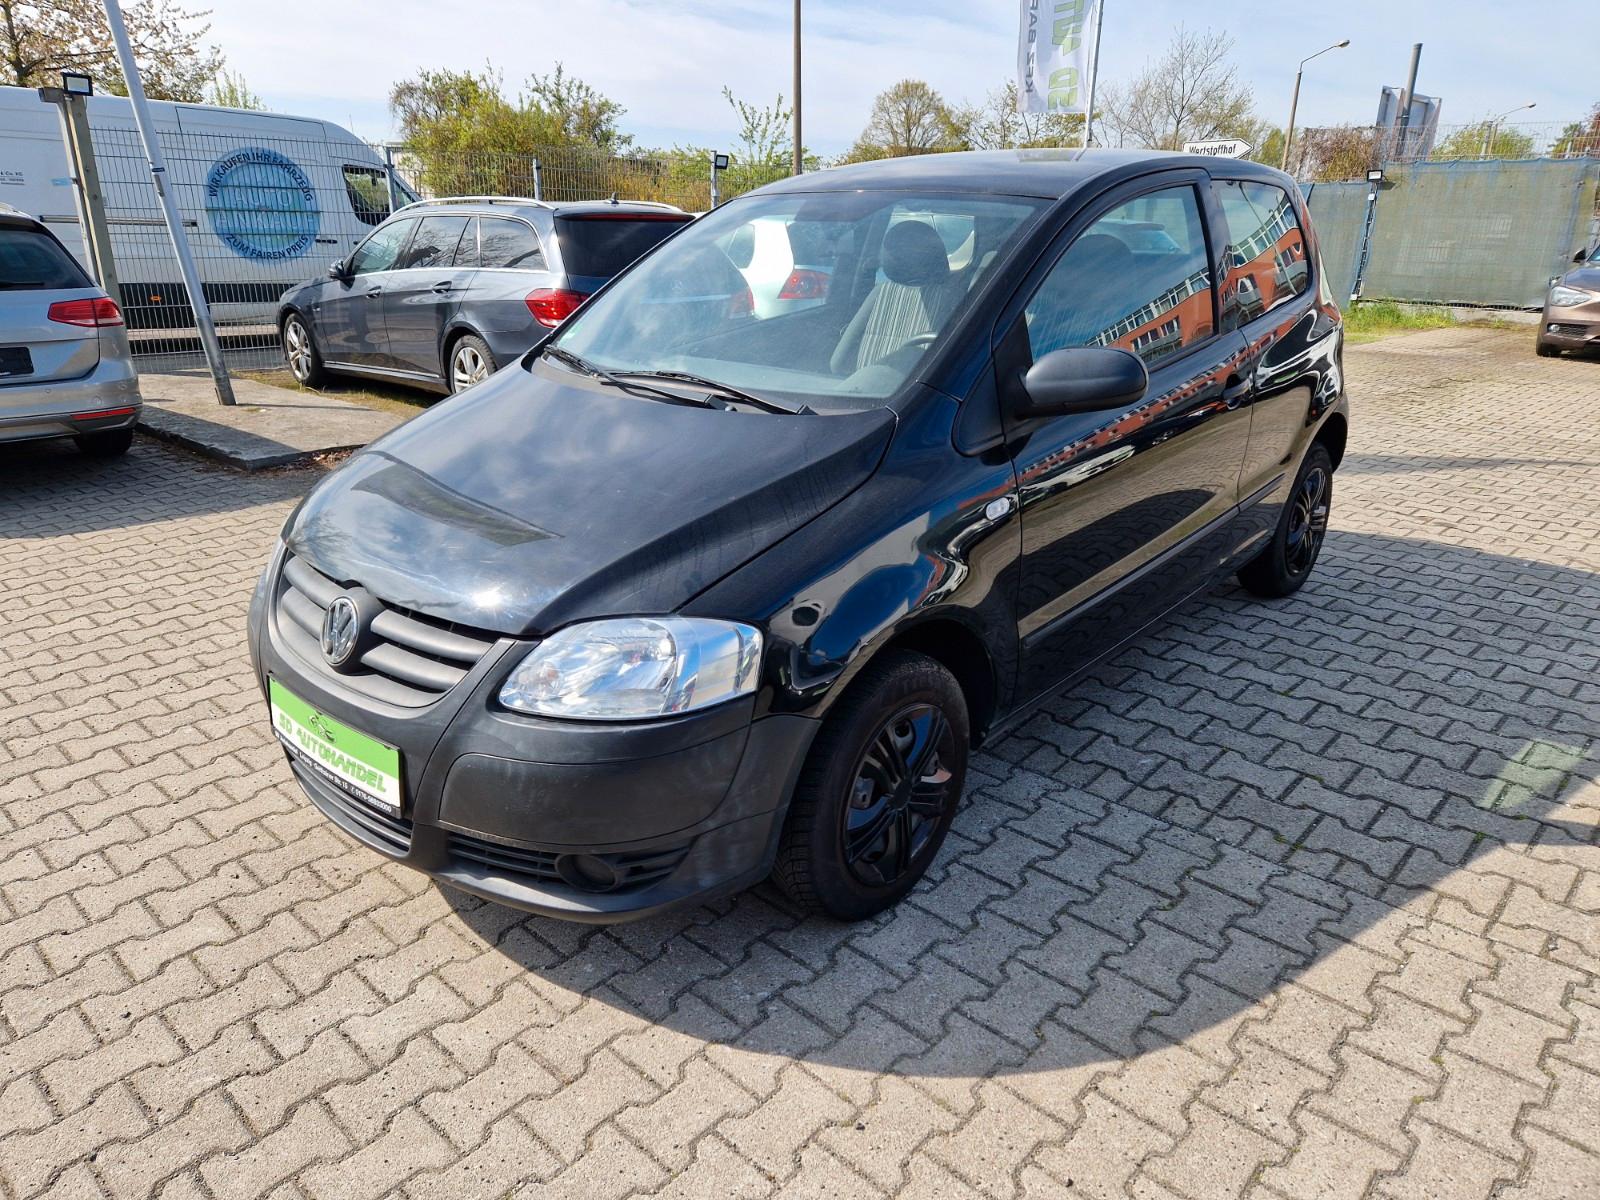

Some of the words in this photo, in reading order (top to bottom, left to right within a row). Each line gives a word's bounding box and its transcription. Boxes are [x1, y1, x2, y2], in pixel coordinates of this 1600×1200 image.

[208, 178, 221, 198] WIR
[215, 152, 251, 179] KAUFEN
[252, 152, 271, 163] IHR
[271, 157, 313, 202] FAHRZEUG
[226, 234, 249, 254] ZUM
[250, 248, 286, 260] FAIREN
[286, 234, 309, 256] PREIS
[279, 712, 293, 735] SD
[296, 727, 387, 793] AUTOHANDEL
